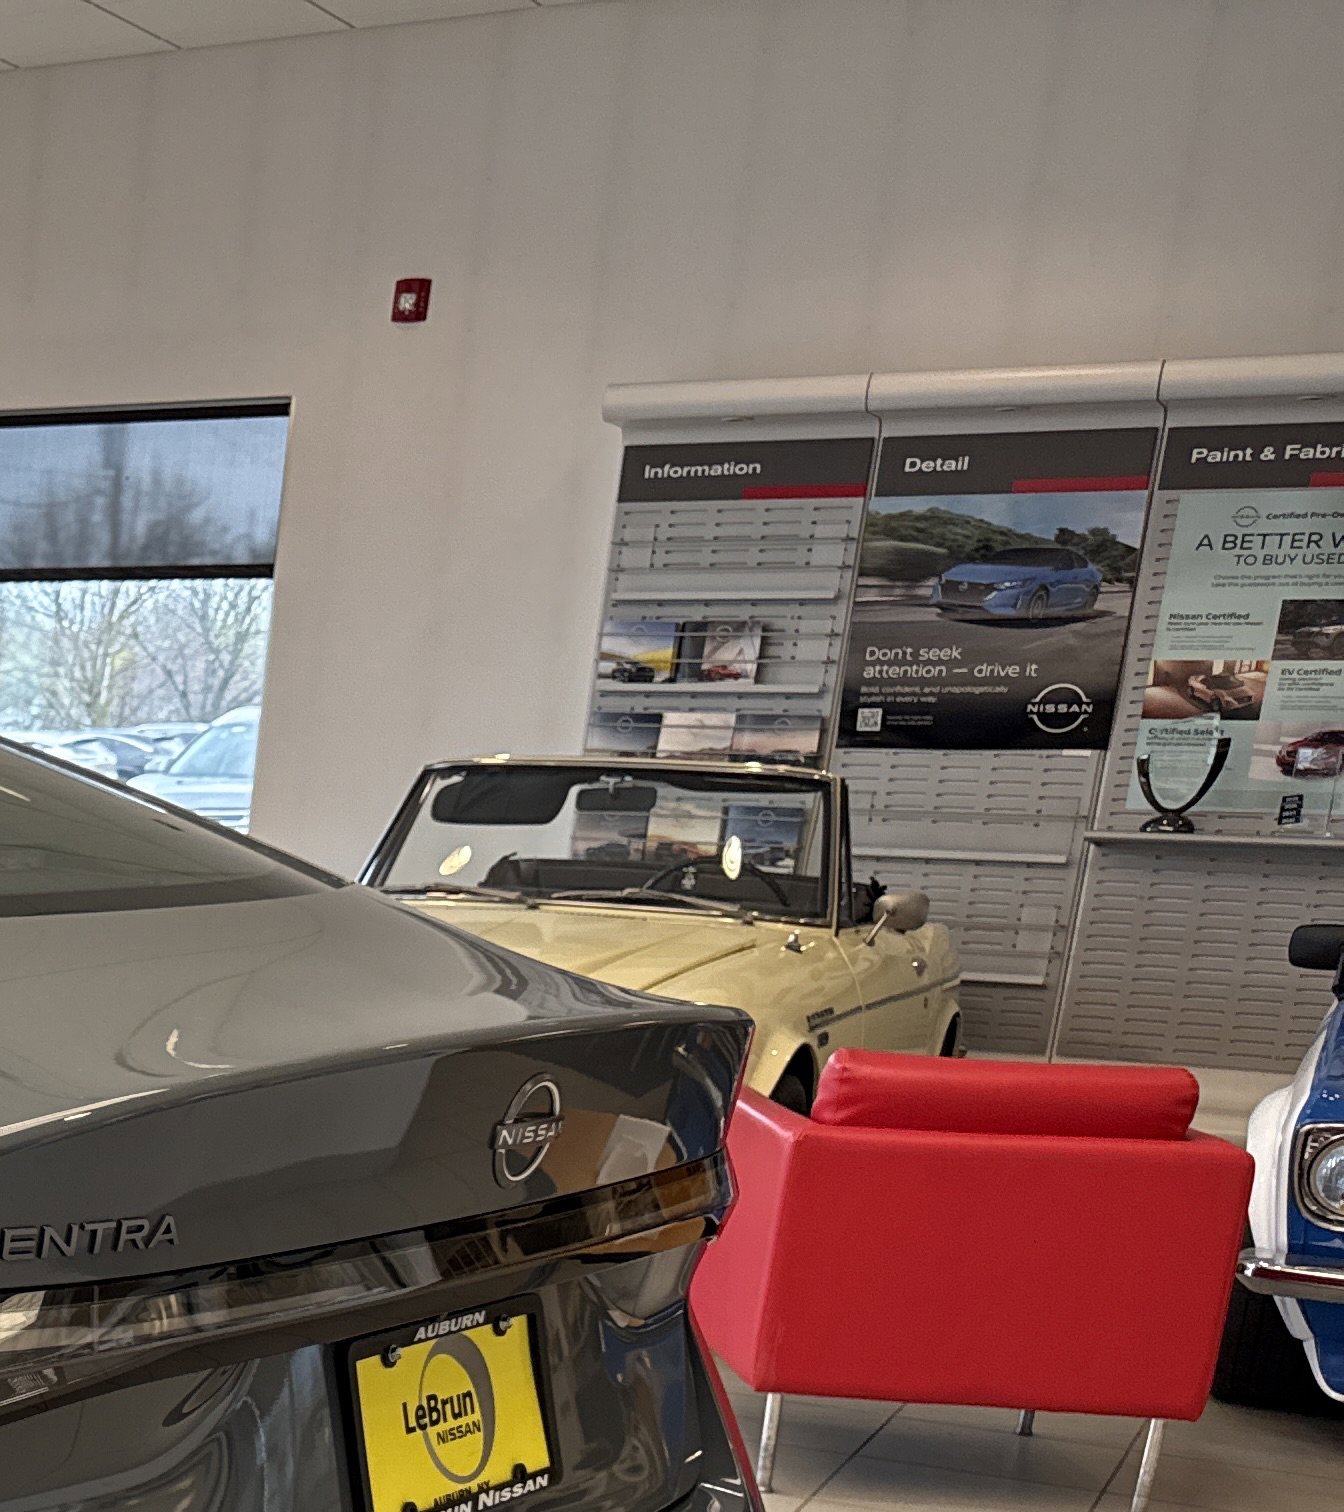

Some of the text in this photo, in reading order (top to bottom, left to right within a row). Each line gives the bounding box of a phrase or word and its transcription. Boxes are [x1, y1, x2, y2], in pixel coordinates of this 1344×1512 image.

[1191, 447, 1254, 463] Paint
[1260, 446, 1276, 461] &
[644, 461, 761, 479] Information
[904, 456, 969, 472] Detail
[1266, 511, 1308, 520] Certified
[1195, 534, 1213, 551] A
[1221, 531, 1324, 550] BETTER
[1234, 554, 1257, 566] TO
[1262, 553, 1299, 566] BUY
[1168, 612, 1250, 621] Nissan Certified
[865, 645, 962, 660] Don't seek
[863, 664, 947, 678] attention
[973, 663, 1020, 677] drive
[1026, 663, 1039, 677] it
[1296, 667, 1342, 676] Certified
[1026, 703, 1093, 713] NISSAN
[1148, 727, 1224, 736] Ctified Selet
[414, 1310, 486, 1341] AUBURN
[402, 1389, 475, 1435] LeBrun
[436, 1419, 481, 1446] NISSAN
